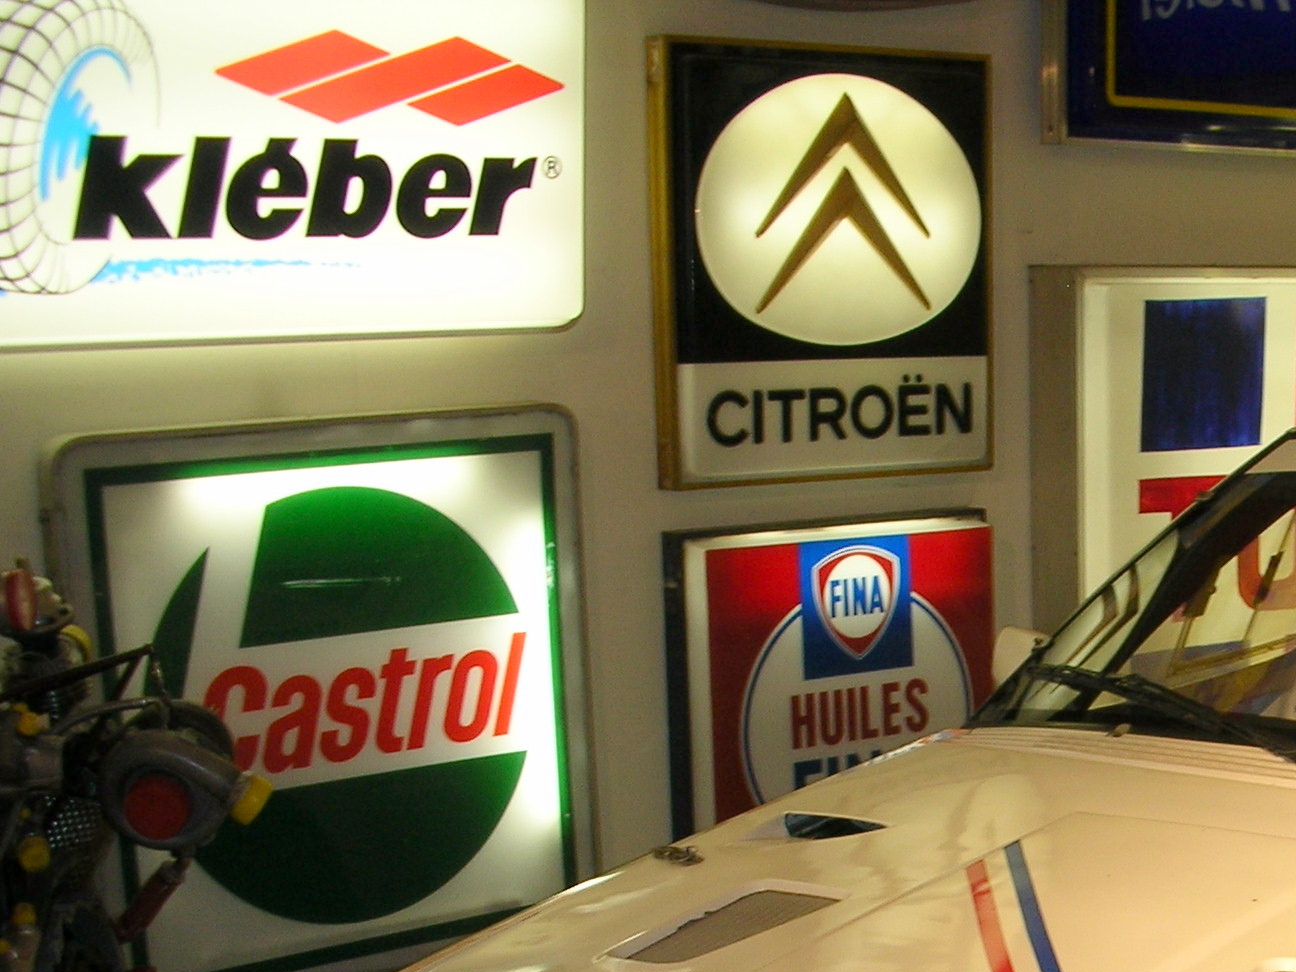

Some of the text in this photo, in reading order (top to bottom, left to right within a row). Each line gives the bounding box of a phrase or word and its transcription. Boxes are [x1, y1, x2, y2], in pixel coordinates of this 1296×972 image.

[72, 135, 538, 240] kléber
[705, 374, 973, 447] CITROËN
[829, 574, 886, 619] FINA
[204, 632, 527, 774] Castrol
[790, 678, 930, 749] HUILES
